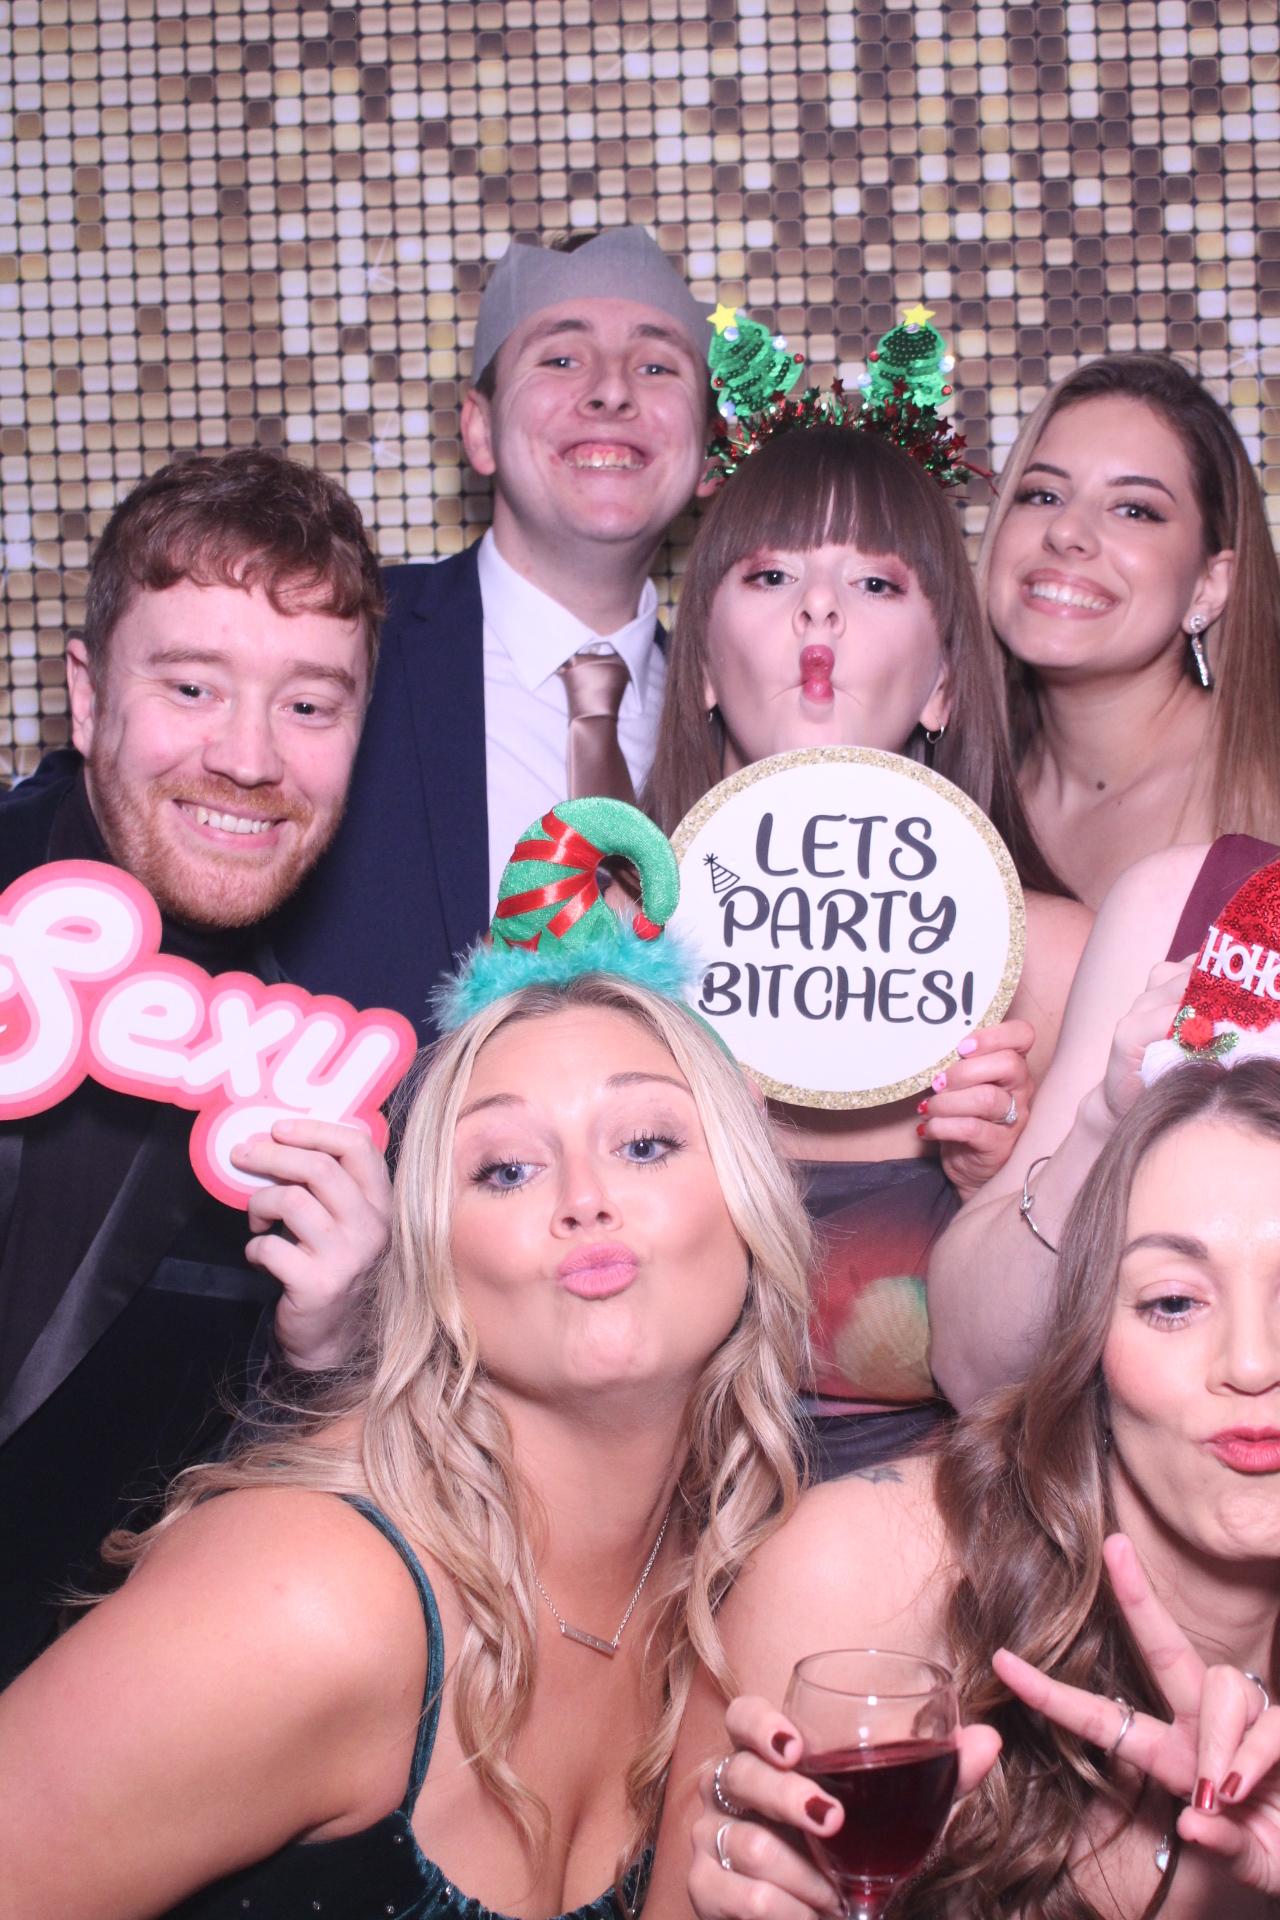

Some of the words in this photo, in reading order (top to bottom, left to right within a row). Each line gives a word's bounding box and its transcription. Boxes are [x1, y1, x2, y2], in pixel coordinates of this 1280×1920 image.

[756, 812, 937, 881] LETS
[719, 885, 957, 954] PARTY
[699, 961, 974, 1026] BITCHES!
[0, 886, 391, 1187] Sexy
